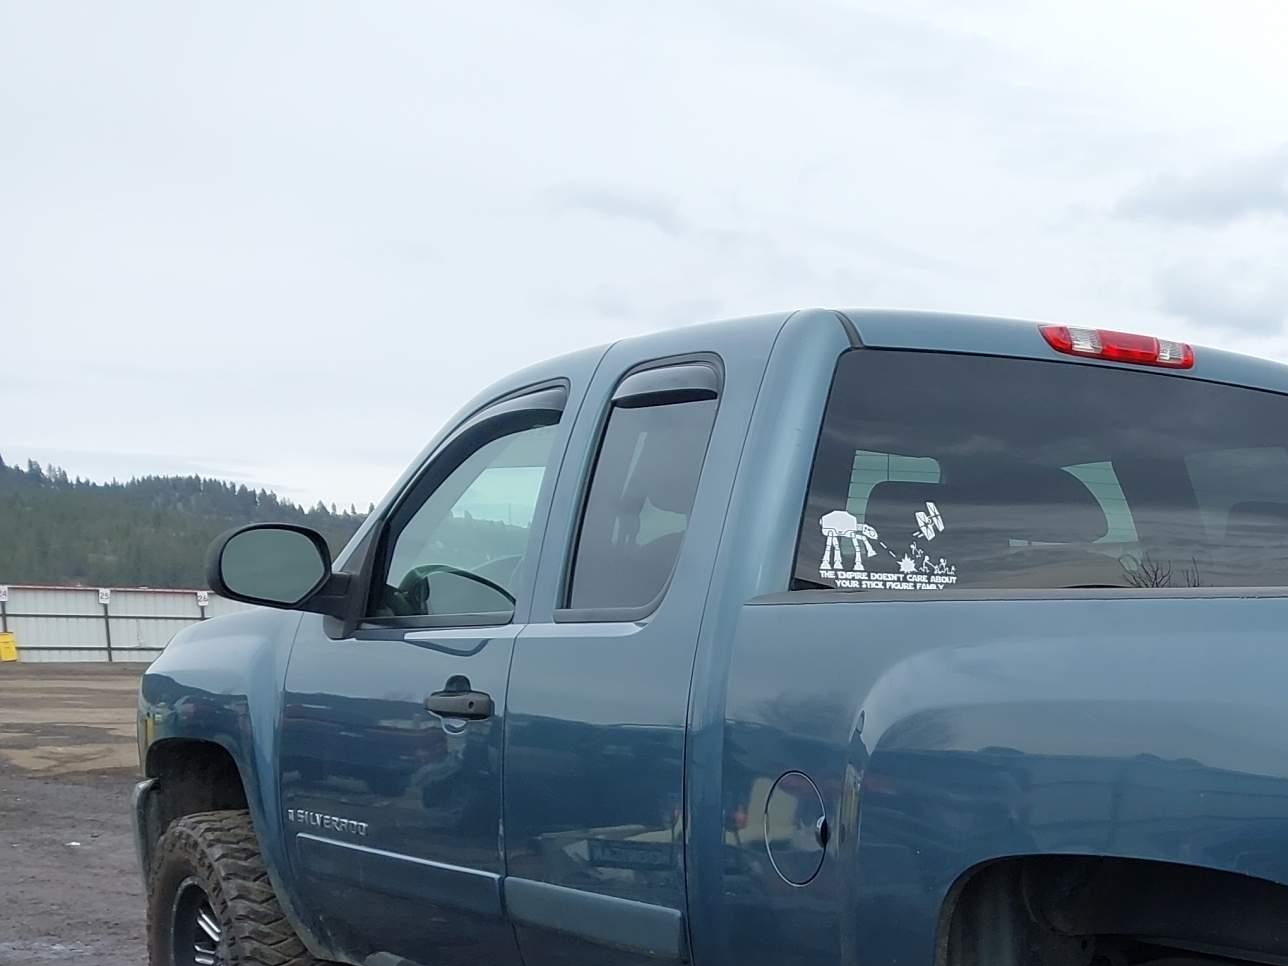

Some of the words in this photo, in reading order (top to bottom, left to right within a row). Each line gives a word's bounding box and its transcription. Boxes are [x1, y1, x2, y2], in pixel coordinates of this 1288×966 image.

[819, 570, 836, 579] THE
[906, 574, 929, 583] CARE
[930, 575, 957, 584] ABOUT
[835, 579, 860, 588] YOUR
[861, 580, 885, 589] STICK
[886, 581, 915, 590] FIGURE
[296, 809, 368, 836] SILVERADO
